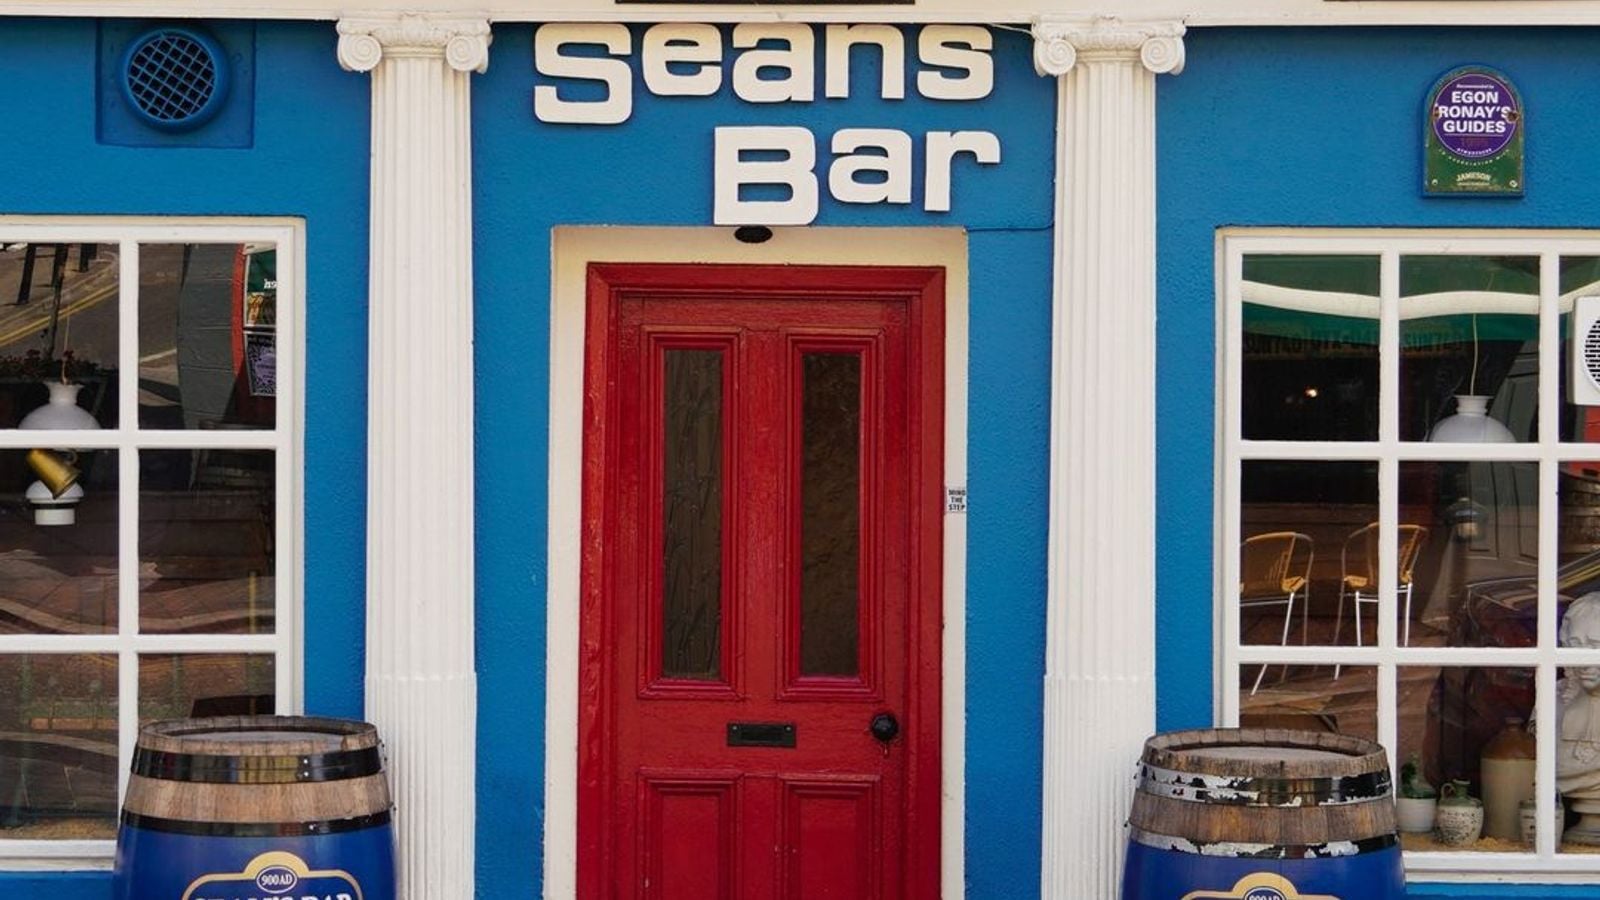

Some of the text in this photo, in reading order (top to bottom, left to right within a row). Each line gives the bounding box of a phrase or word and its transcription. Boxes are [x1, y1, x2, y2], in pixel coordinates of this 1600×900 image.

[533, 22, 994, 125] Seans
[1451, 91, 1499, 104] EGON
[1438, 105, 1511, 119] RONAY'S
[1442, 120, 1506, 133] GUIDES
[713, 125, 1001, 226] Bar
[1456, 171, 1492, 182] JAMESON
